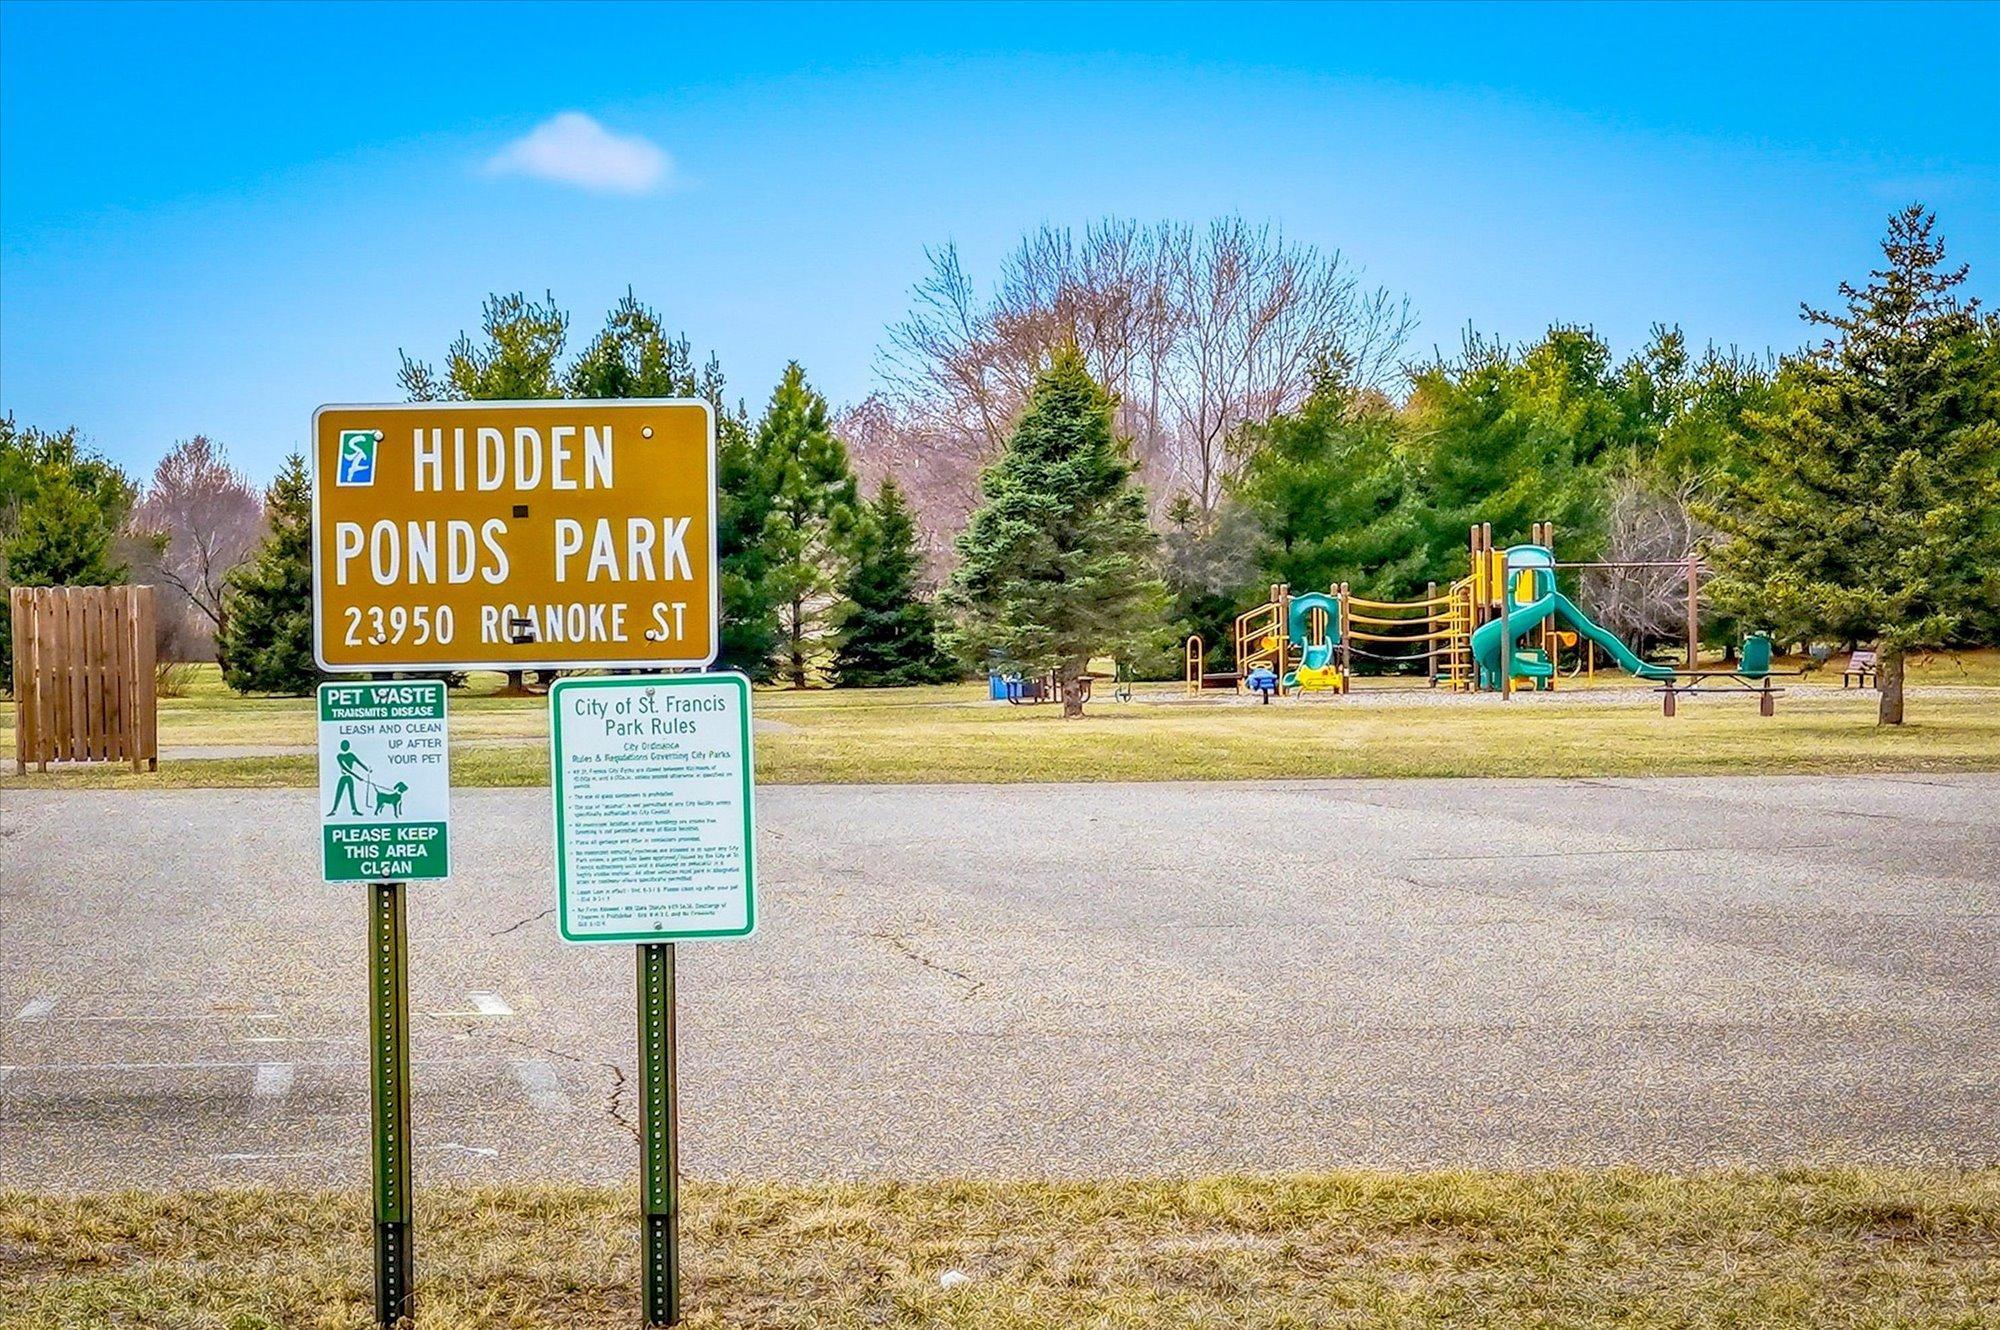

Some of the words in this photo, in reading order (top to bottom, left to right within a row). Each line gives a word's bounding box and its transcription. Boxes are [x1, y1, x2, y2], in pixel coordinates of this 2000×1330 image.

[413, 426, 614, 492] HIDDEN
[336, 519, 510, 585] PONDS
[555, 517, 694, 582] PARK
[344, 605, 454, 646] 23950
[481, 603, 627, 644] ROANOKE
[651, 602, 687, 642] ST
[328, 689, 363, 706] PET
[371, 687, 437, 704] WASTE
[331, 707, 388, 718] TRANSMITS
[391, 706, 434, 717] DISEASE
[575, 698, 608, 719] City
[615, 697, 632, 715] of
[638, 696, 659, 714] St.
[666, 694, 726, 712] Francis
[340, 725, 375, 735] LEASH
[379, 724, 401, 734] AND
[406, 723, 442, 733] CLEAN
[605, 718, 644, 736] Park
[651, 717, 697, 735] Rules
[388, 739, 403, 749] UP
[407, 738, 442, 749] AFTER
[388, 754, 417, 764] YOUR
[421, 754, 442, 764] PET
[691, 751, 706, 760] City
[709, 750, 731, 759] Parks
[332, 828, 391, 843] PLEASE
[397, 826, 438, 841] KEEP
[344, 845, 379, 859] THIS
[385, 844, 428, 858] AREA
